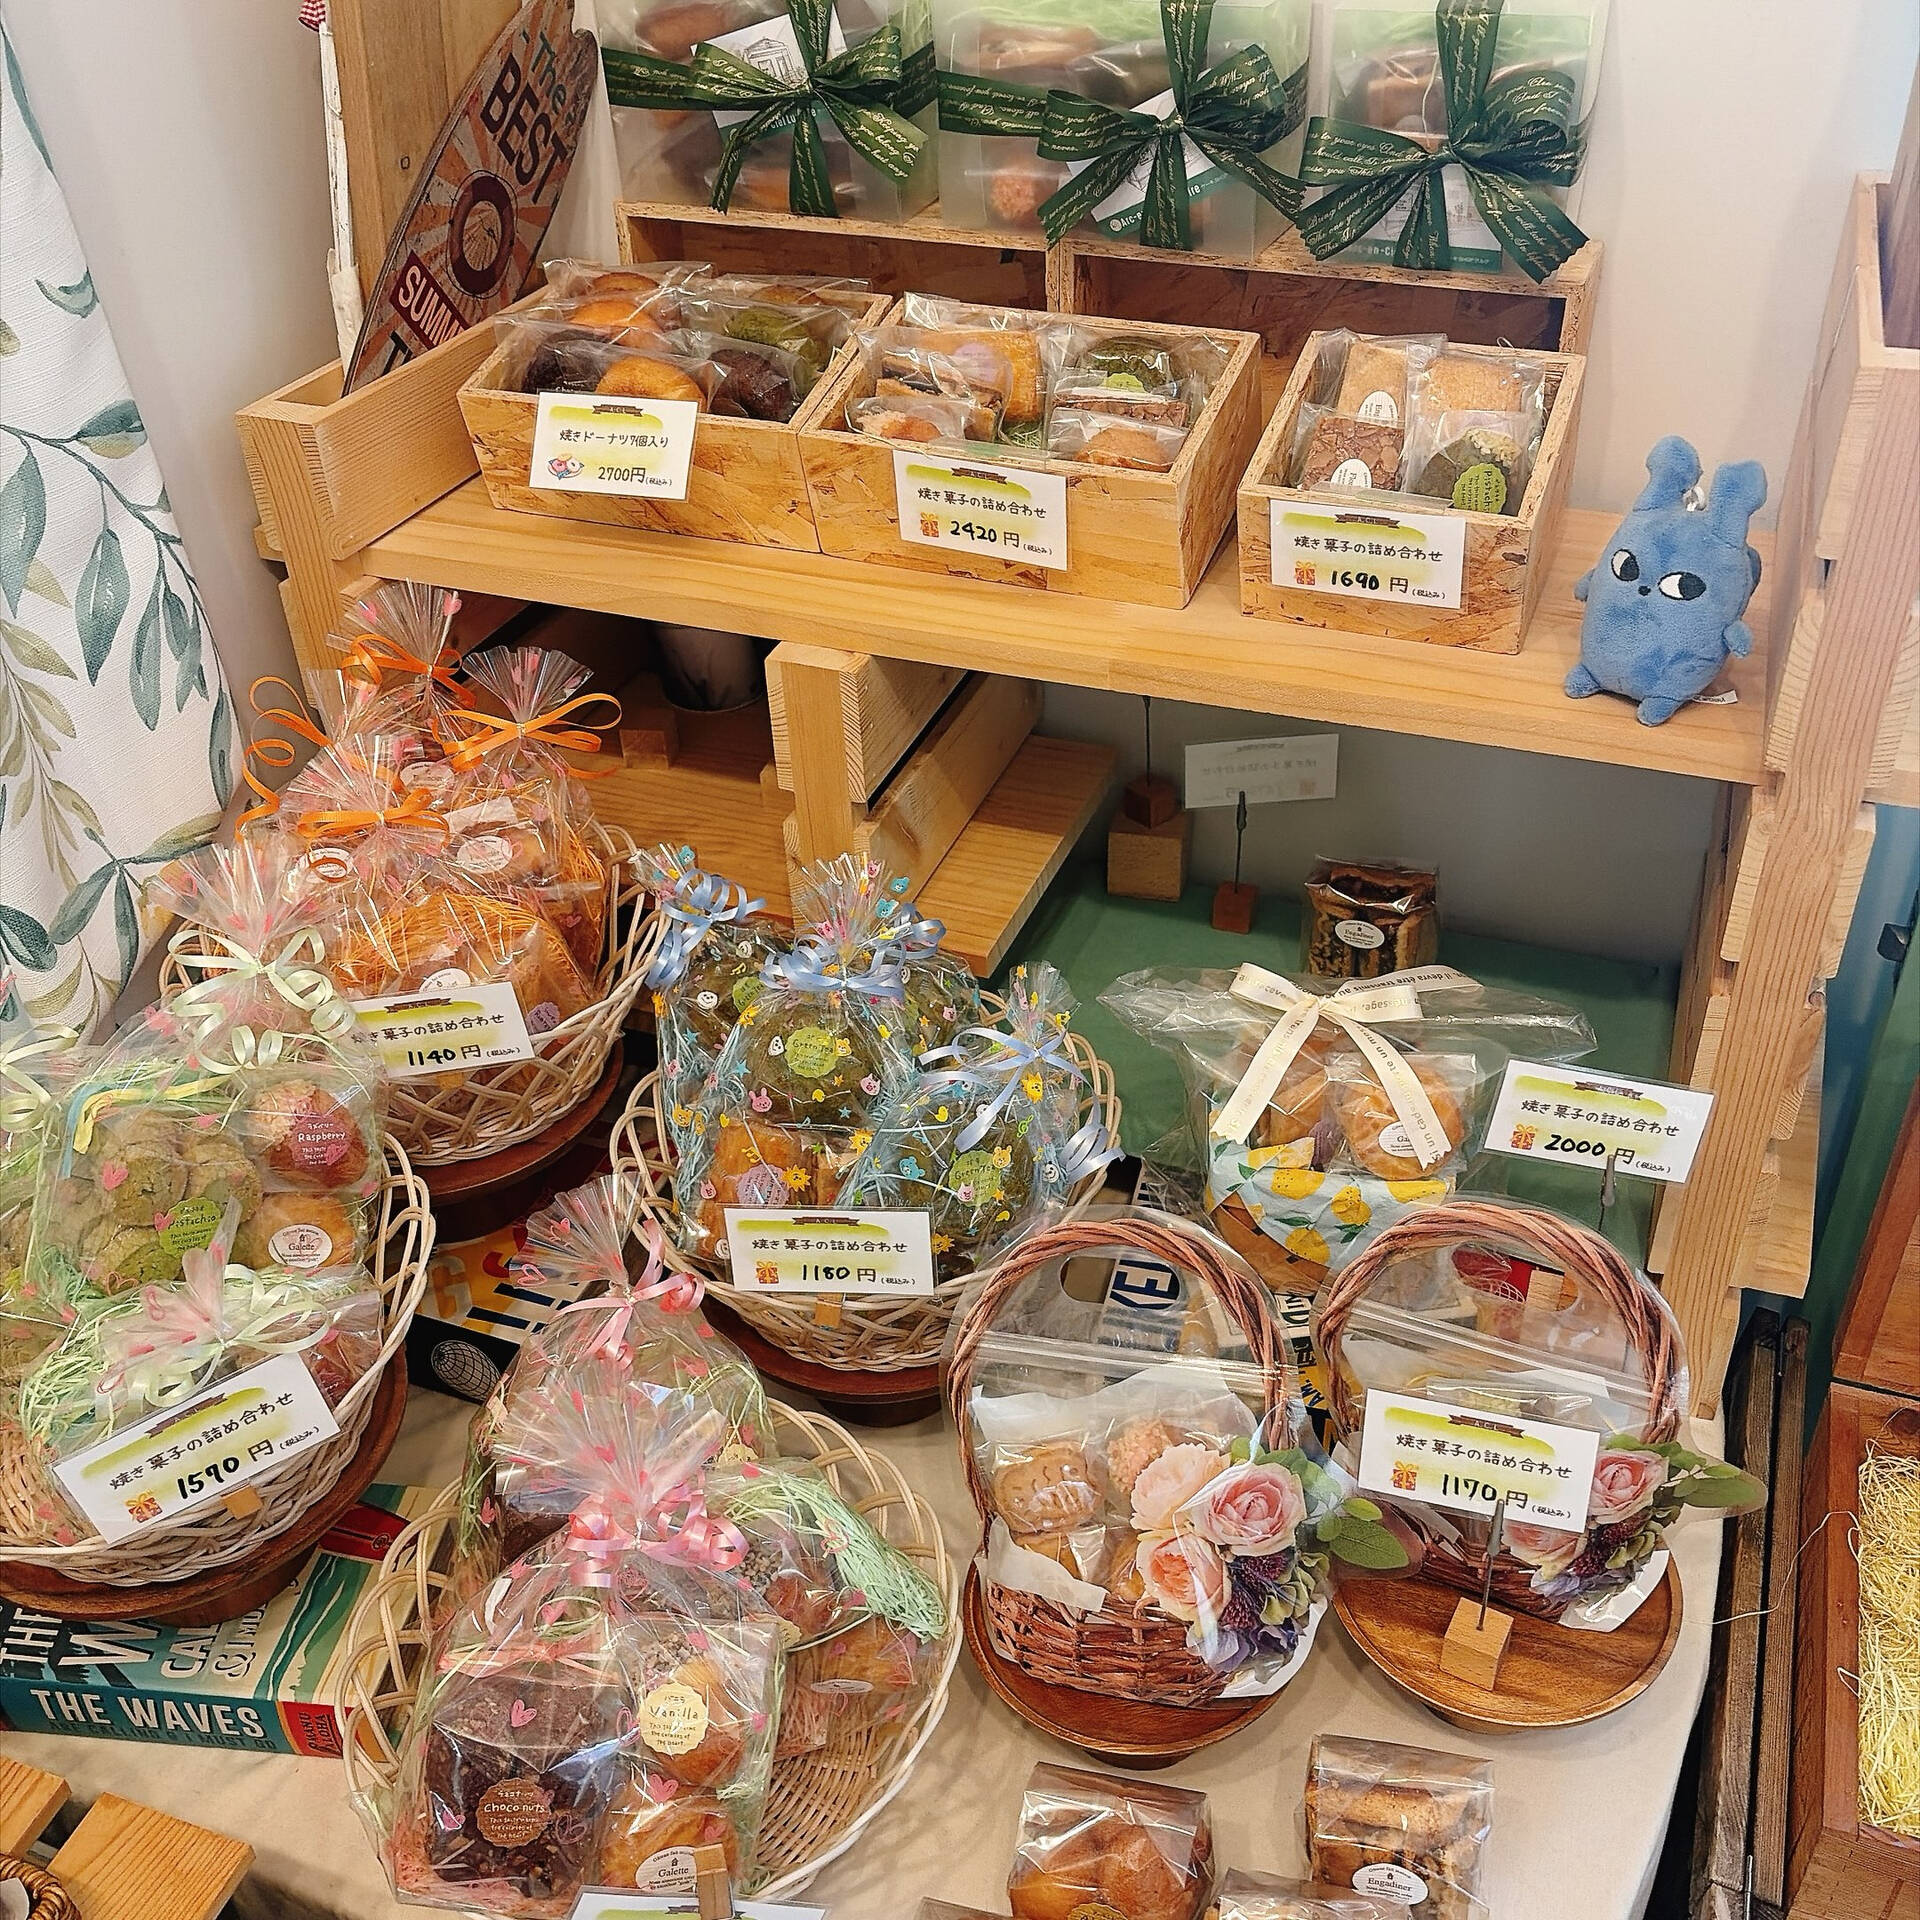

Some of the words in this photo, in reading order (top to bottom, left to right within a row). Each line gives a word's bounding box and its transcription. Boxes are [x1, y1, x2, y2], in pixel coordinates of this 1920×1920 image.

[481, 53, 568, 205] BEST
[559, 428, 669, 449] 焼きドーナツ7個入り
[917, 487, 1047, 519] 焼き菓子の詰め合わせ
[1293, 536, 1443, 562] 焼き菓子の詰め合わせ
[1521, 1100, 1680, 1137] 焼き菓子の詰め合わせ
[298, 1132, 346, 1142] Raspberry
[751, 1238, 908, 1253] 焼き菓子の詰め合わせ
[110, 1391, 295, 1490] 焼き菓子の詰め合わせ
[1396, 1433, 1572, 1479] 焼き菓子の詰め合わせ
[30, 1689, 112, 1725] THE
[119, 1696, 265, 1739] WAVES
[650, 1706, 698, 1720] Vanilla
[523, 1803, 545, 1813] nuts
[658, 1867, 689, 1878] Galette
[1367, 1877, 1414, 1892] Engadiner
